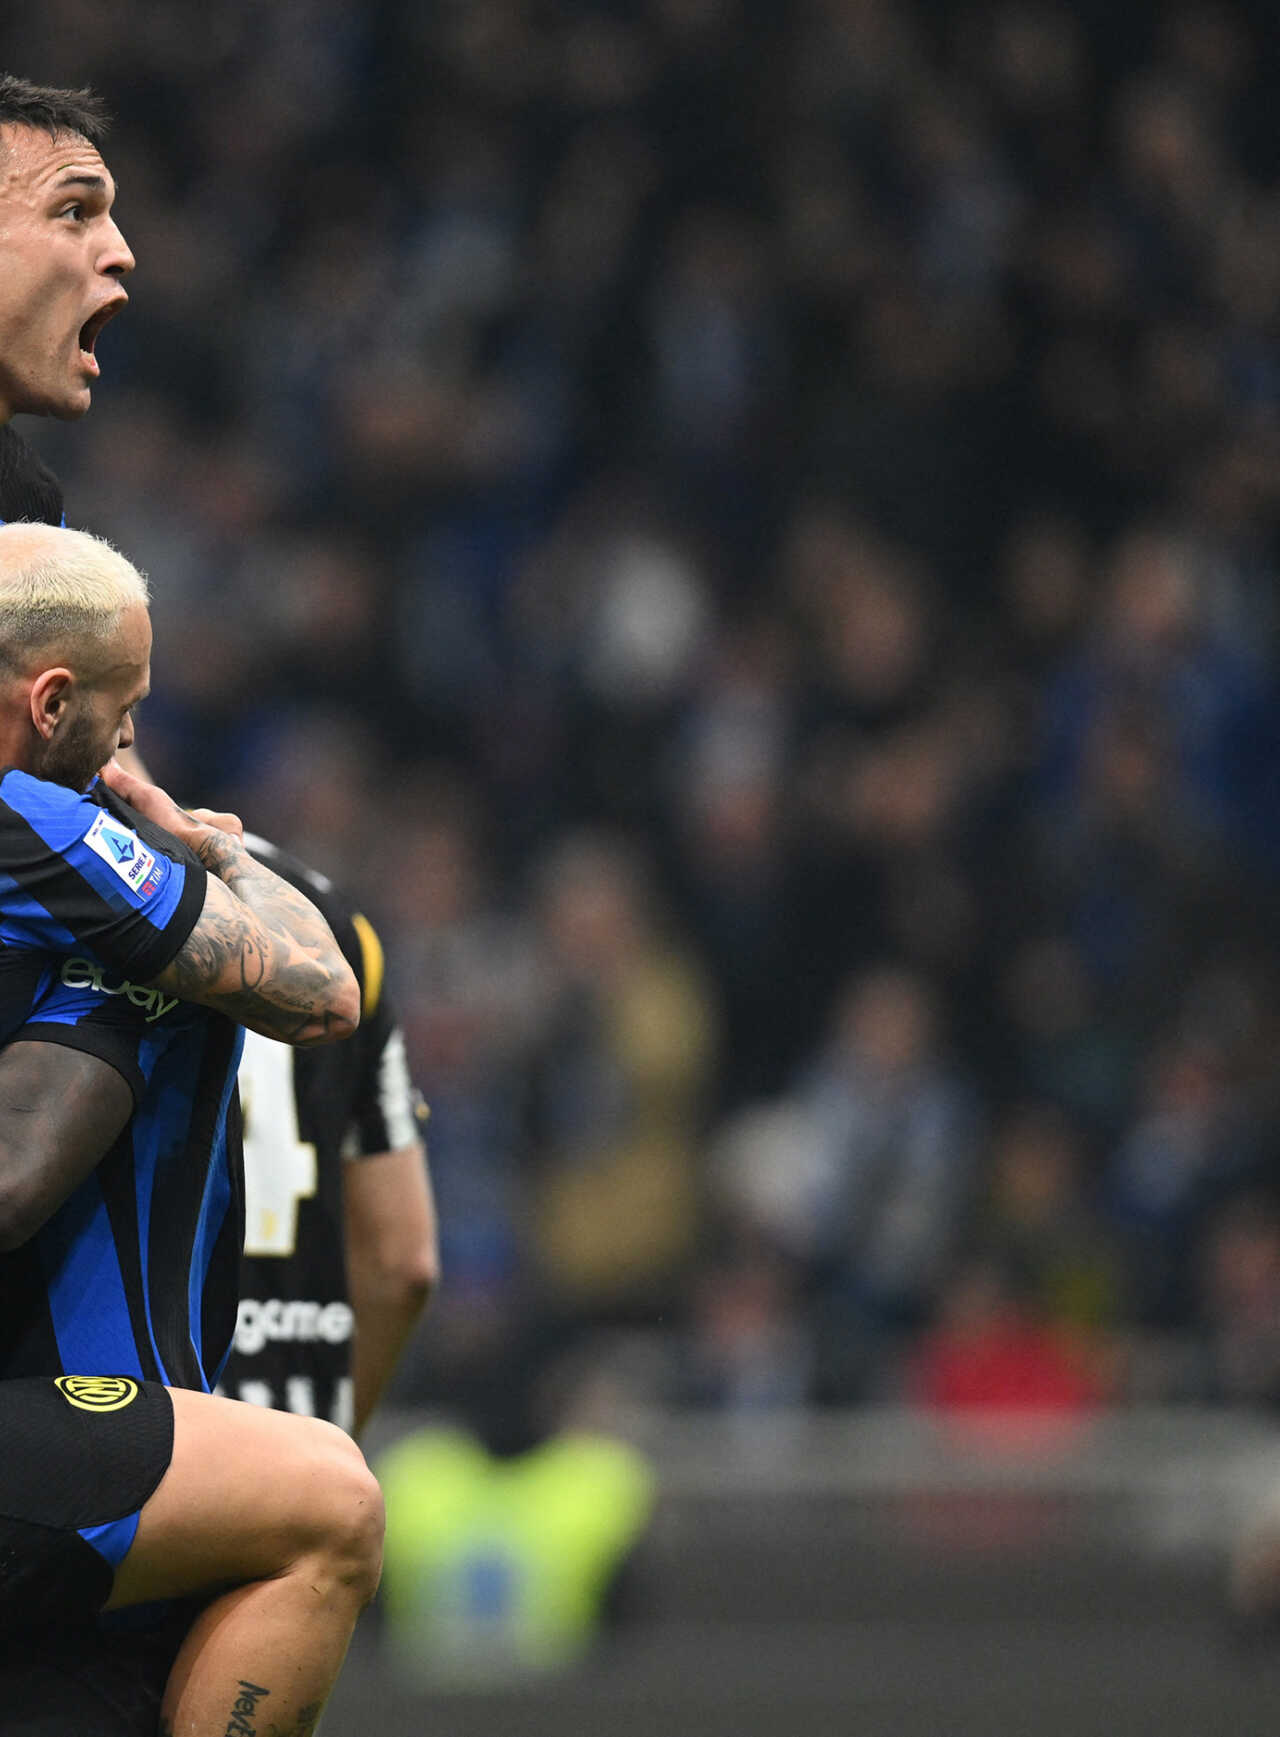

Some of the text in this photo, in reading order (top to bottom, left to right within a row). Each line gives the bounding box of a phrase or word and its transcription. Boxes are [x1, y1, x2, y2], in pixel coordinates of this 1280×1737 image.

[128, 857, 147, 880] SERIE
[149, 867, 164, 885] TIM
[234, 1298, 356, 1355] game
